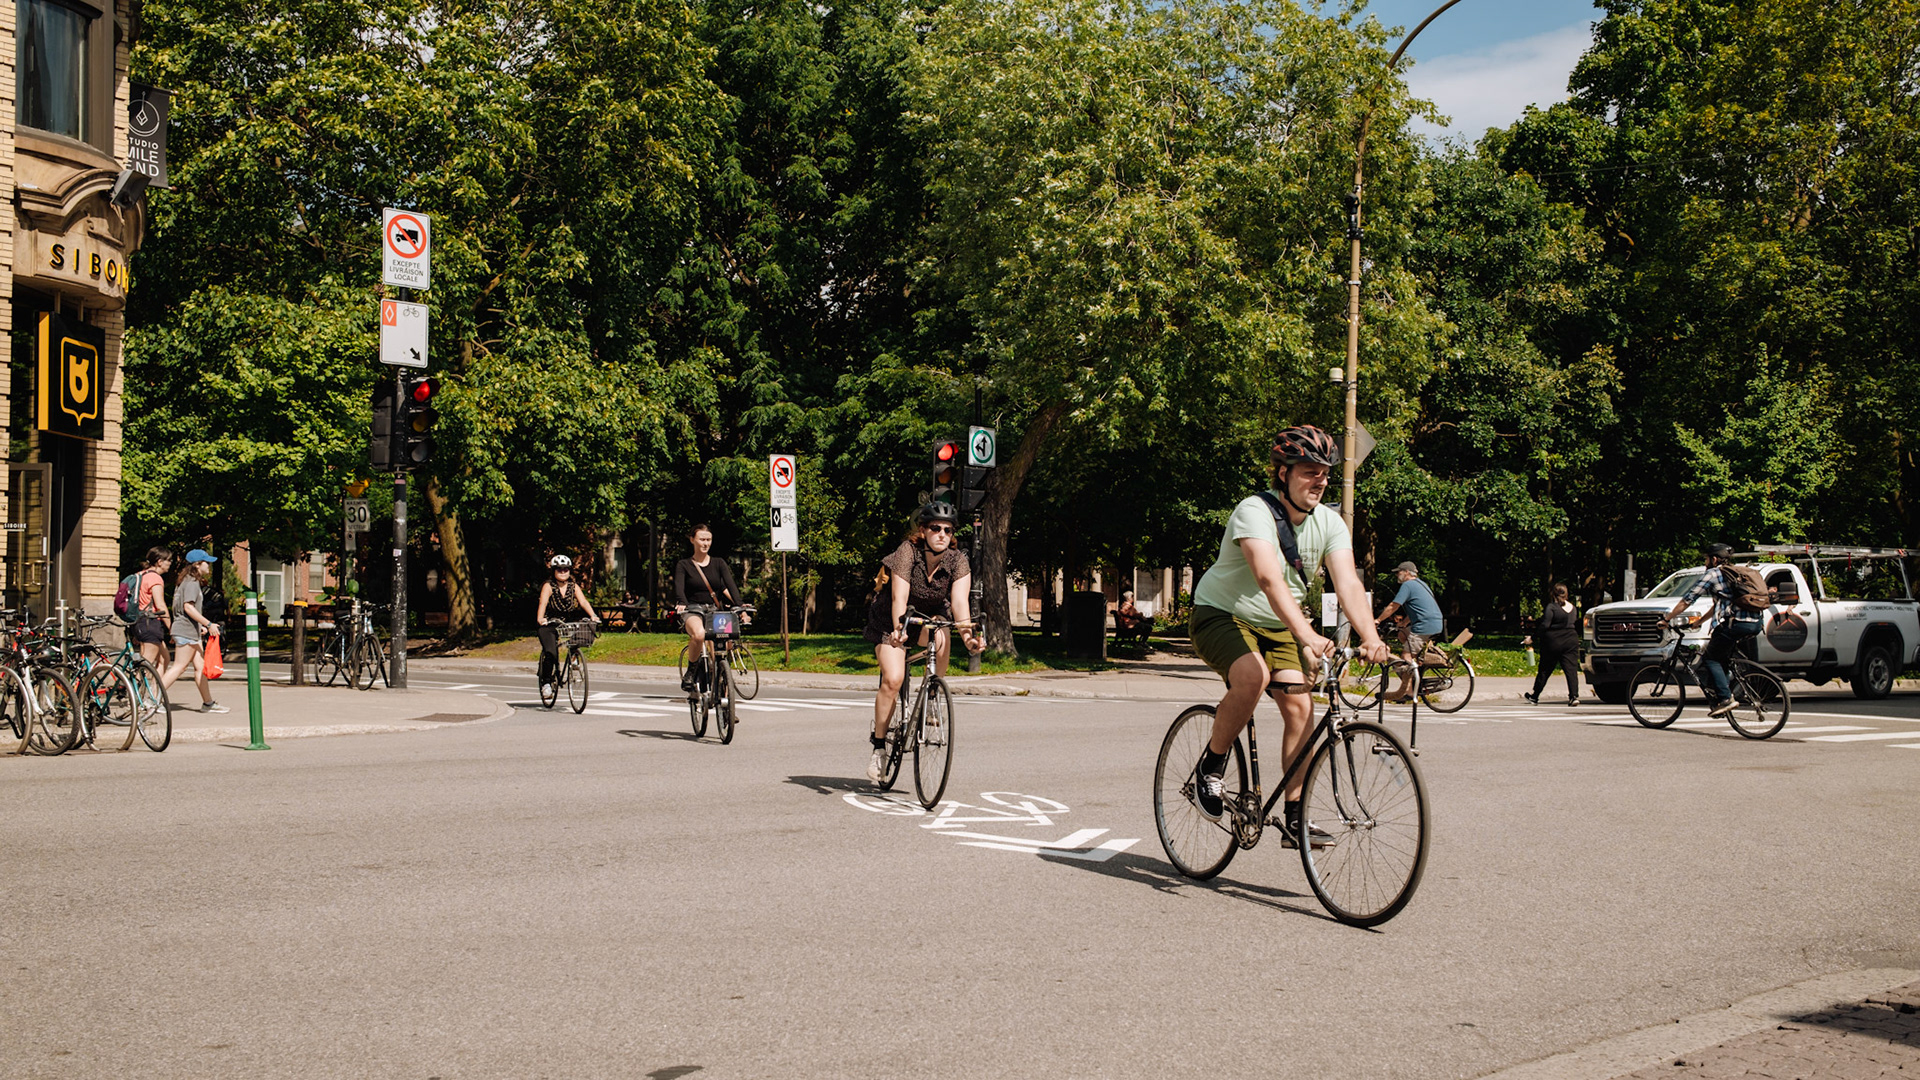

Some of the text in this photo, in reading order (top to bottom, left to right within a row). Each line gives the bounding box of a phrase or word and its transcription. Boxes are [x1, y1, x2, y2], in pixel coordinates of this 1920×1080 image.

[129, 137, 159, 150] TUDIO
[389, 265, 424, 277] LIVRAISON
[394, 273, 418, 283] LOCALE
[348, 506, 367, 523] 30
[1612, 622, 1642, 632] GMC
